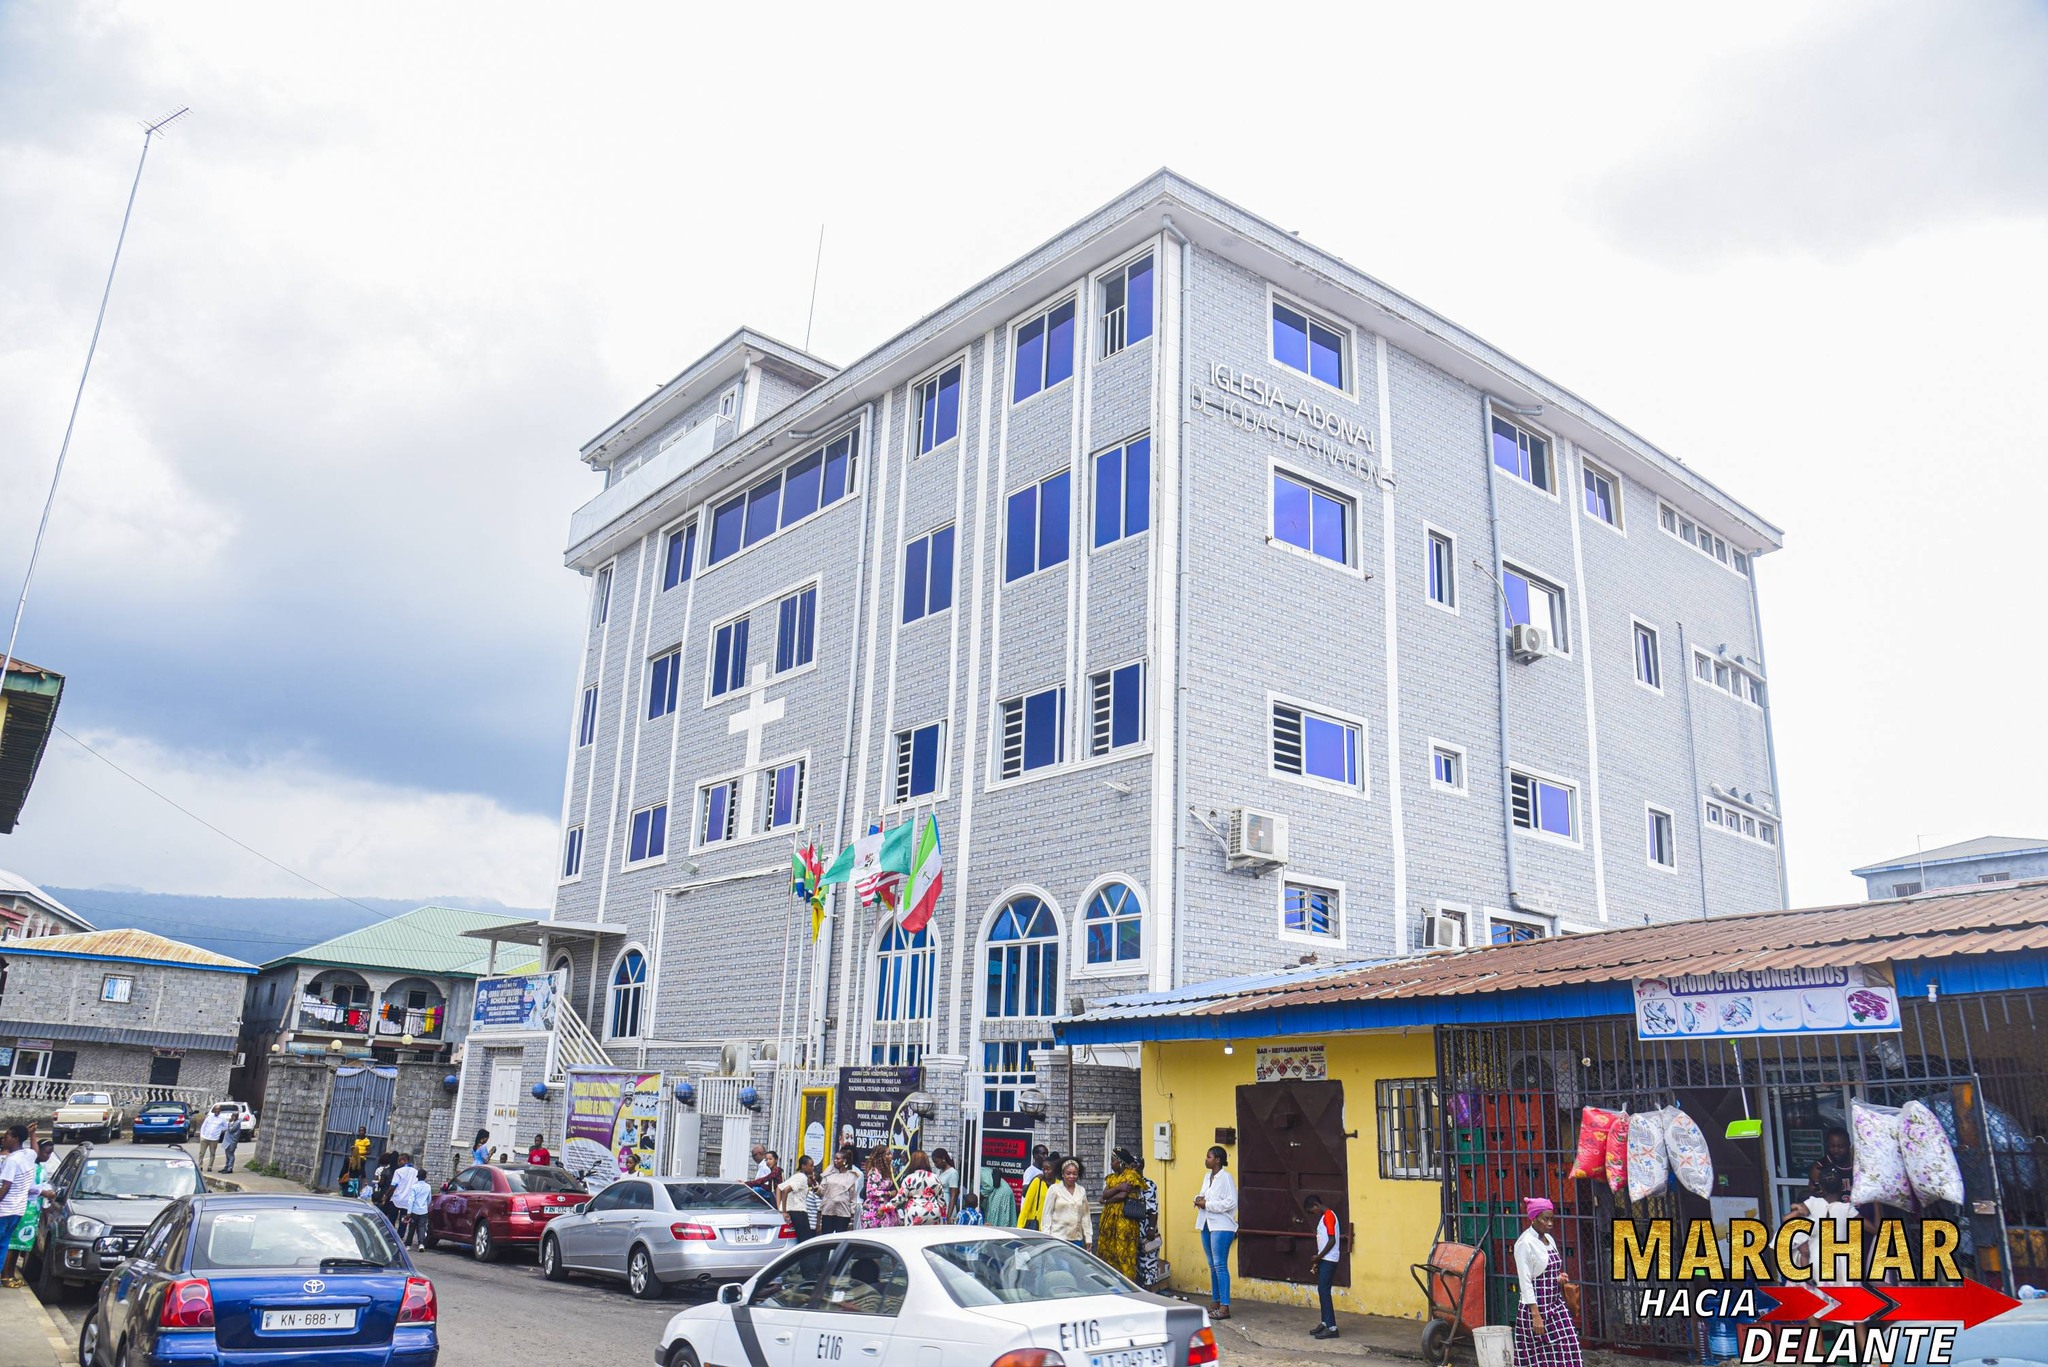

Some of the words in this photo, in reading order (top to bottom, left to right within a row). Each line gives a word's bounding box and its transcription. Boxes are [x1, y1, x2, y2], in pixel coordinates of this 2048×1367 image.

[1210, 360, 1287, 414] IGLESIA
[1294, 399, 1375, 453] ADONAI
[1190, 383, 1214, 417] DE
[1219, 394, 1281, 443] TODAS
[1284, 422, 1320, 458] LAS
[1322, 441, 1399, 492] NACIONES
[1671, 970, 1750, 994] PRODUCTOS
[1751, 965, 1846, 989] CONGELADOS
[1271, 1046, 1308, 1054] RESTAURANTE
[855, 1128, 889, 1139] MARAVILLAS
[856, 1138, 867, 1148] DE
[868, 1138, 888, 1149] DIOS
